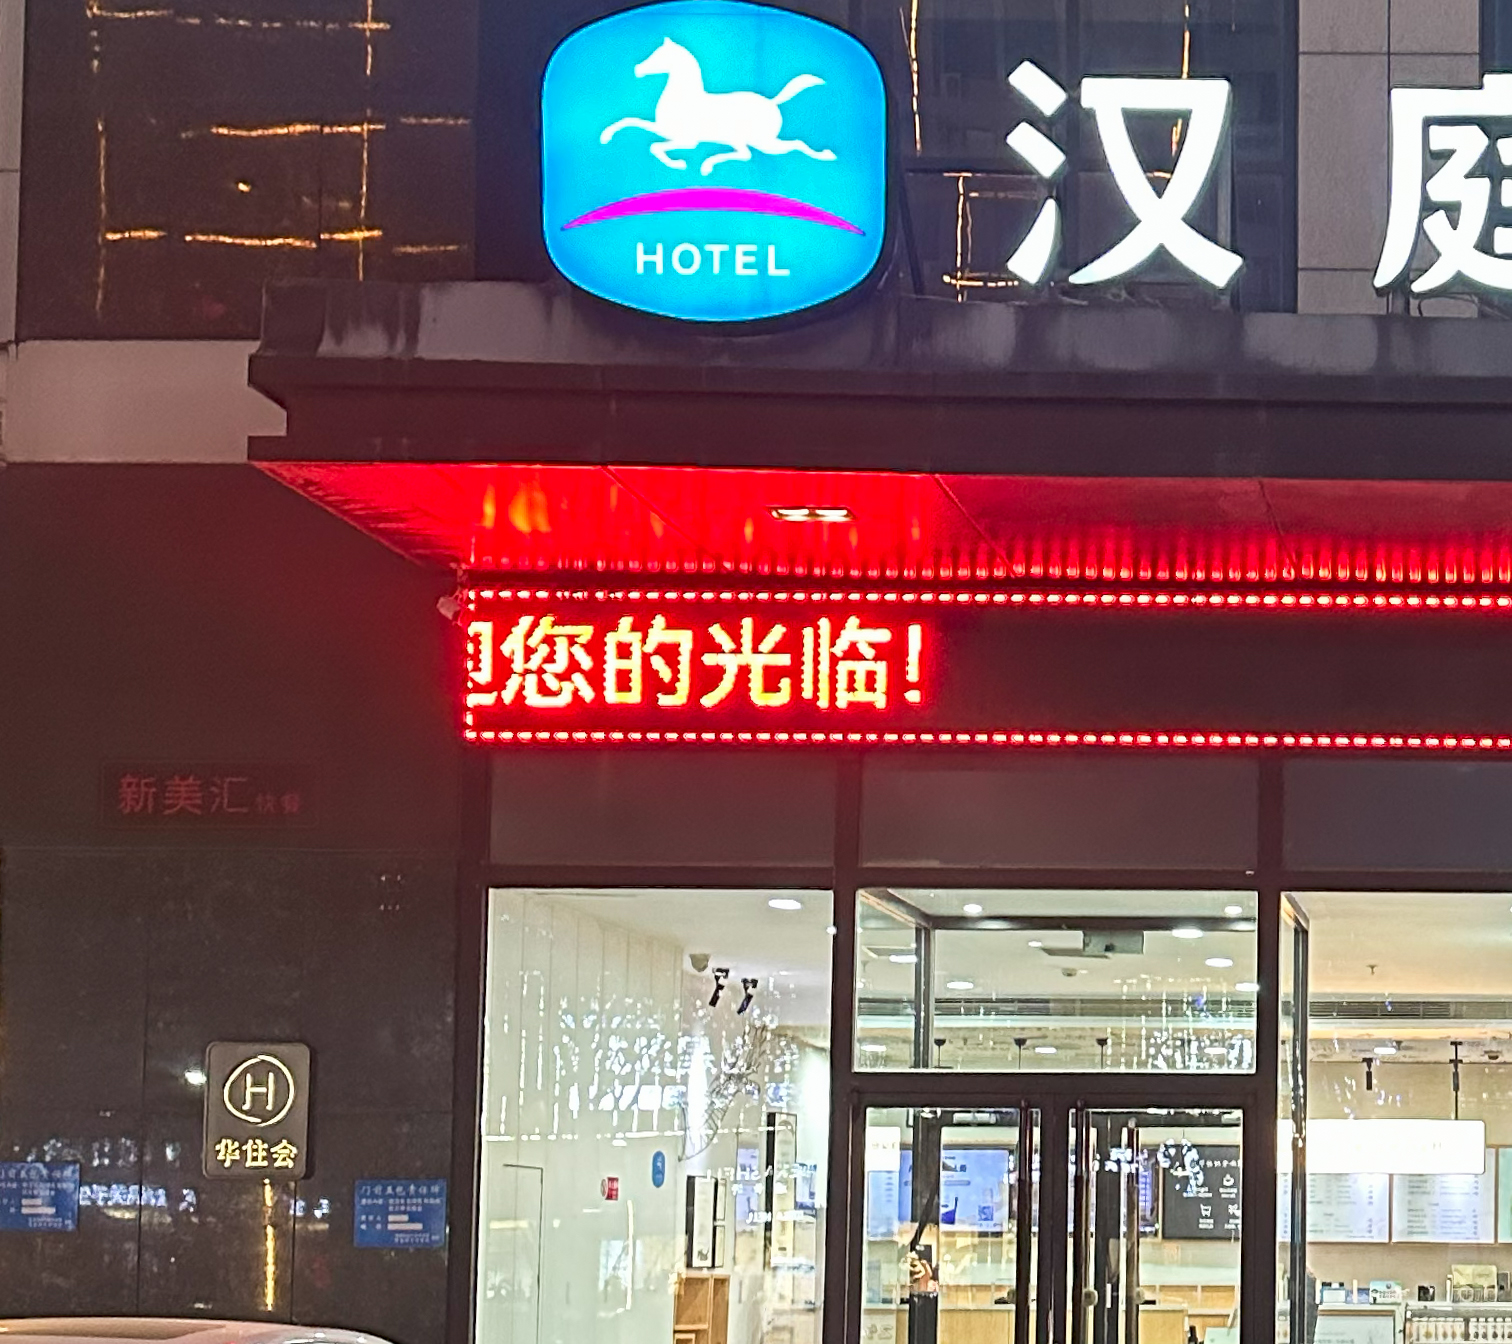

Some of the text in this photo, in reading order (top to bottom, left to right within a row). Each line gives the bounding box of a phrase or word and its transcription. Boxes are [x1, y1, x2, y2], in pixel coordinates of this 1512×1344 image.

[636, 241, 791, 277] HOTEL
[215, 1138, 298, 1169] 华住会
